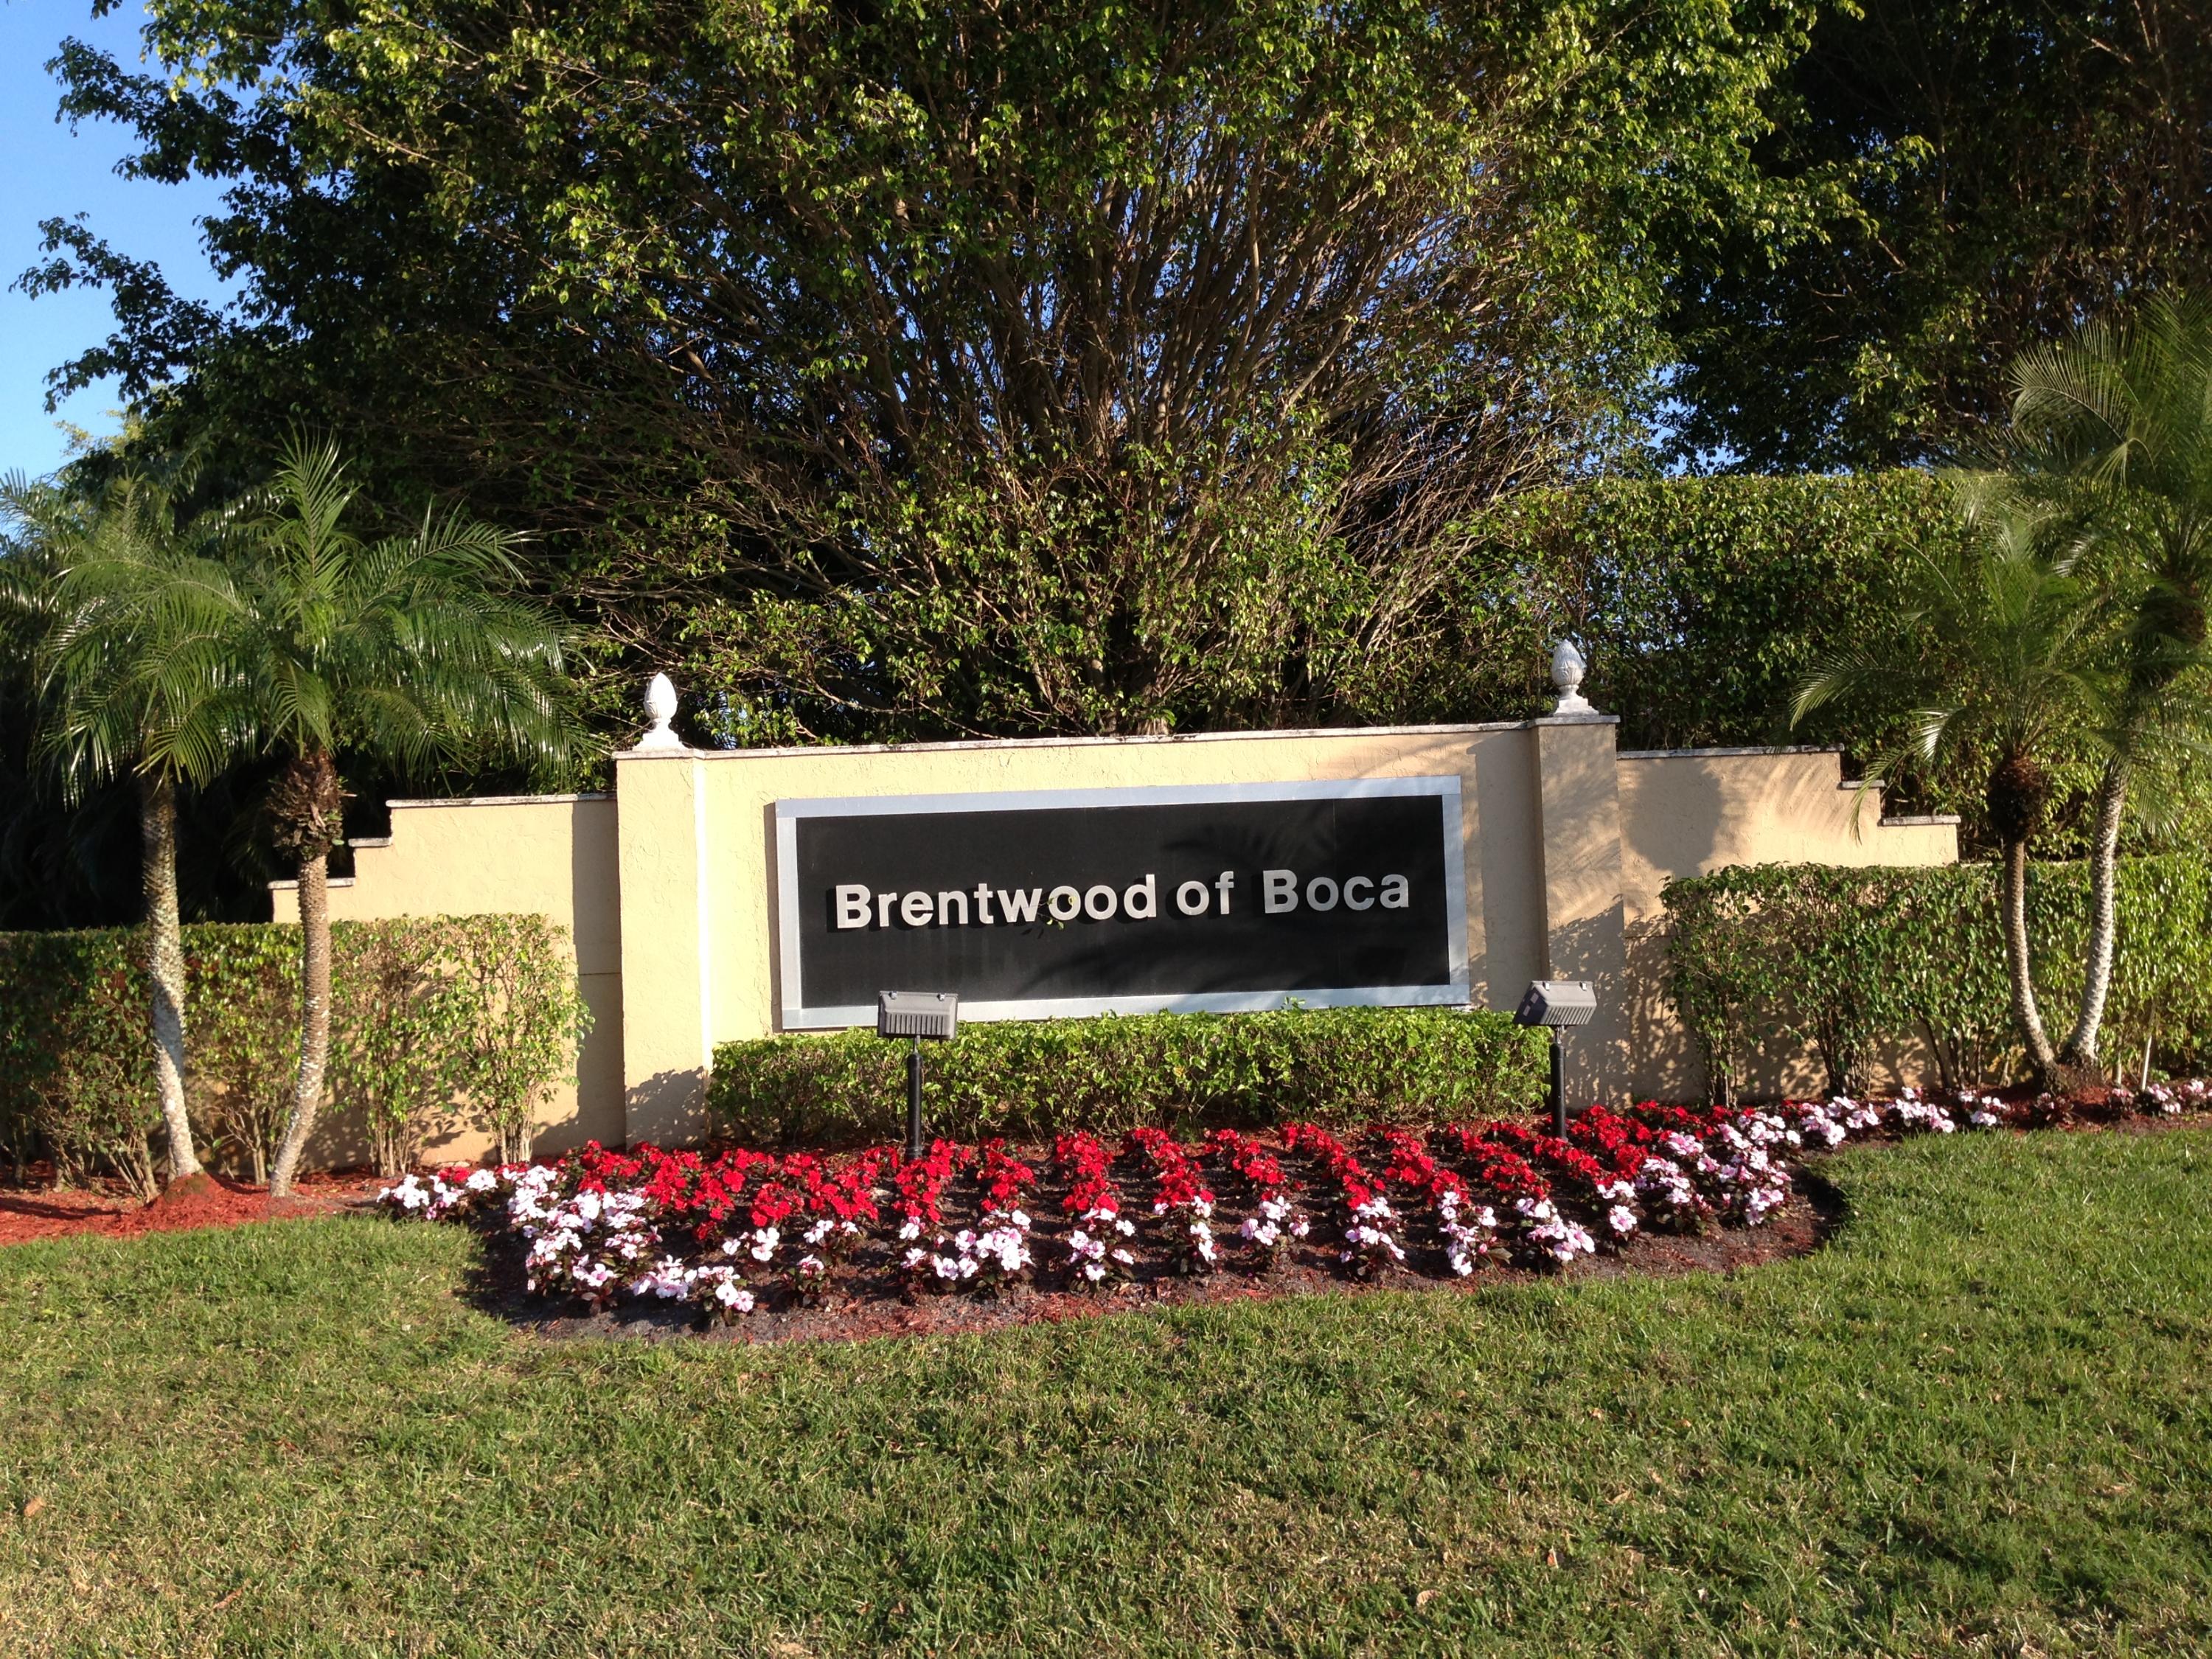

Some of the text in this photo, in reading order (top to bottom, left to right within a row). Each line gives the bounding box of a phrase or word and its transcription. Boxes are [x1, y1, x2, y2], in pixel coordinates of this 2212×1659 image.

[835, 869, 1410, 930] Brentwood of Boca
